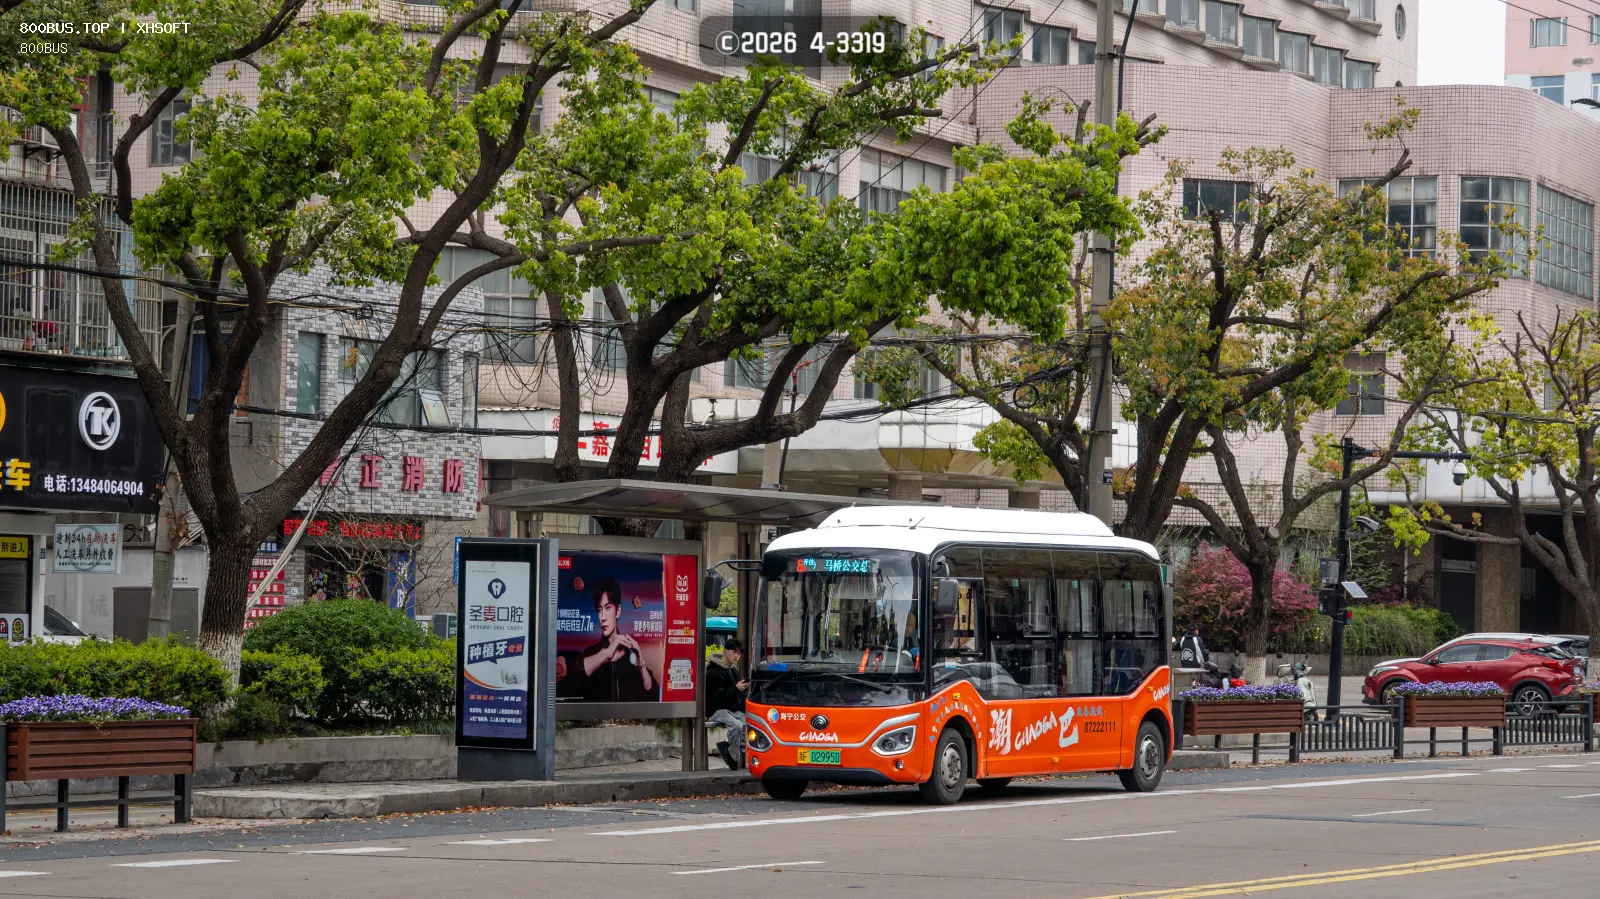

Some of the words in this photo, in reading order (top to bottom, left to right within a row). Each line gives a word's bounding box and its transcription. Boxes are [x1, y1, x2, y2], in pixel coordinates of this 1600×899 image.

[0, 458, 31, 491] 车
[44, 474, 144, 496] 电话:13484064904
[55, 548, 114, 560] 人工洗车另外收费
[824, 559, 869, 573] 马桥公交总
[468, 604, 524, 623] 圣麦口腔
[780, 712, 807, 721] 海宁公交
[988, 708, 1012, 755] 潮
[1014, 711, 1058, 750] CHAOBA
[1058, 706, 1079, 749] 巴
[1084, 721, 1116, 732] 87222111
[799, 731, 839, 743] CHAOBA
